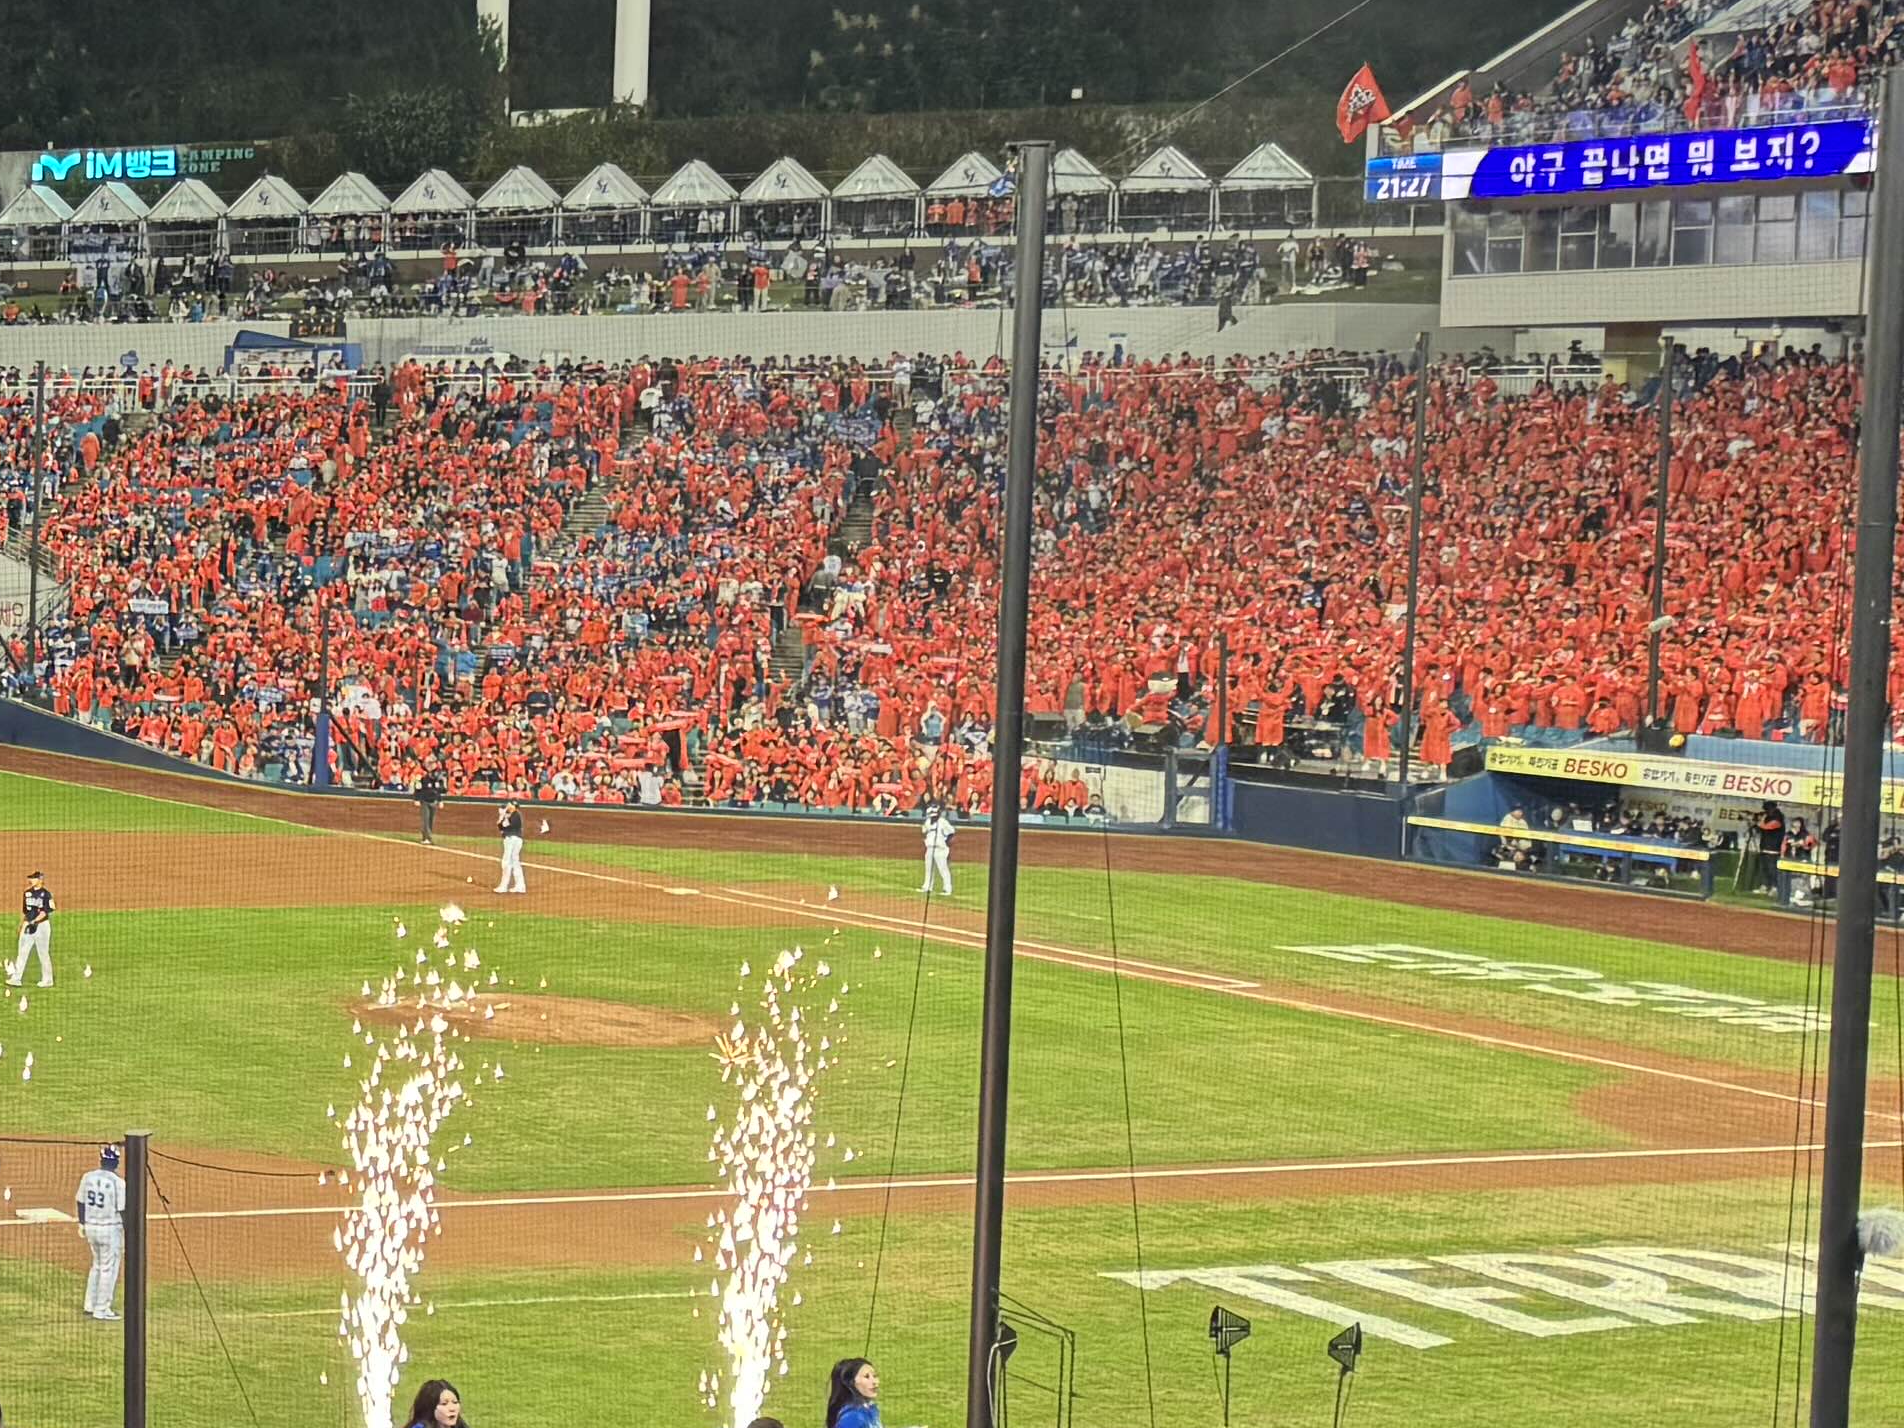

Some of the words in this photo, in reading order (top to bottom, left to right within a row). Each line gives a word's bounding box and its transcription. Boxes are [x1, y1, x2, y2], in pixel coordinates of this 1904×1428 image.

[85, 148, 176, 179] iM뱅크
[1510, 150, 1566, 190] 야구
[1579, 141, 1670, 186] 끝나면
[1729, 131, 1821, 172] 보지?
[1376, 172, 1431, 200] 21:27
[1563, 757, 1628, 780] BESKO
[1721, 774, 1793, 797] BESKO
[87, 1190, 105, 1209] 93
